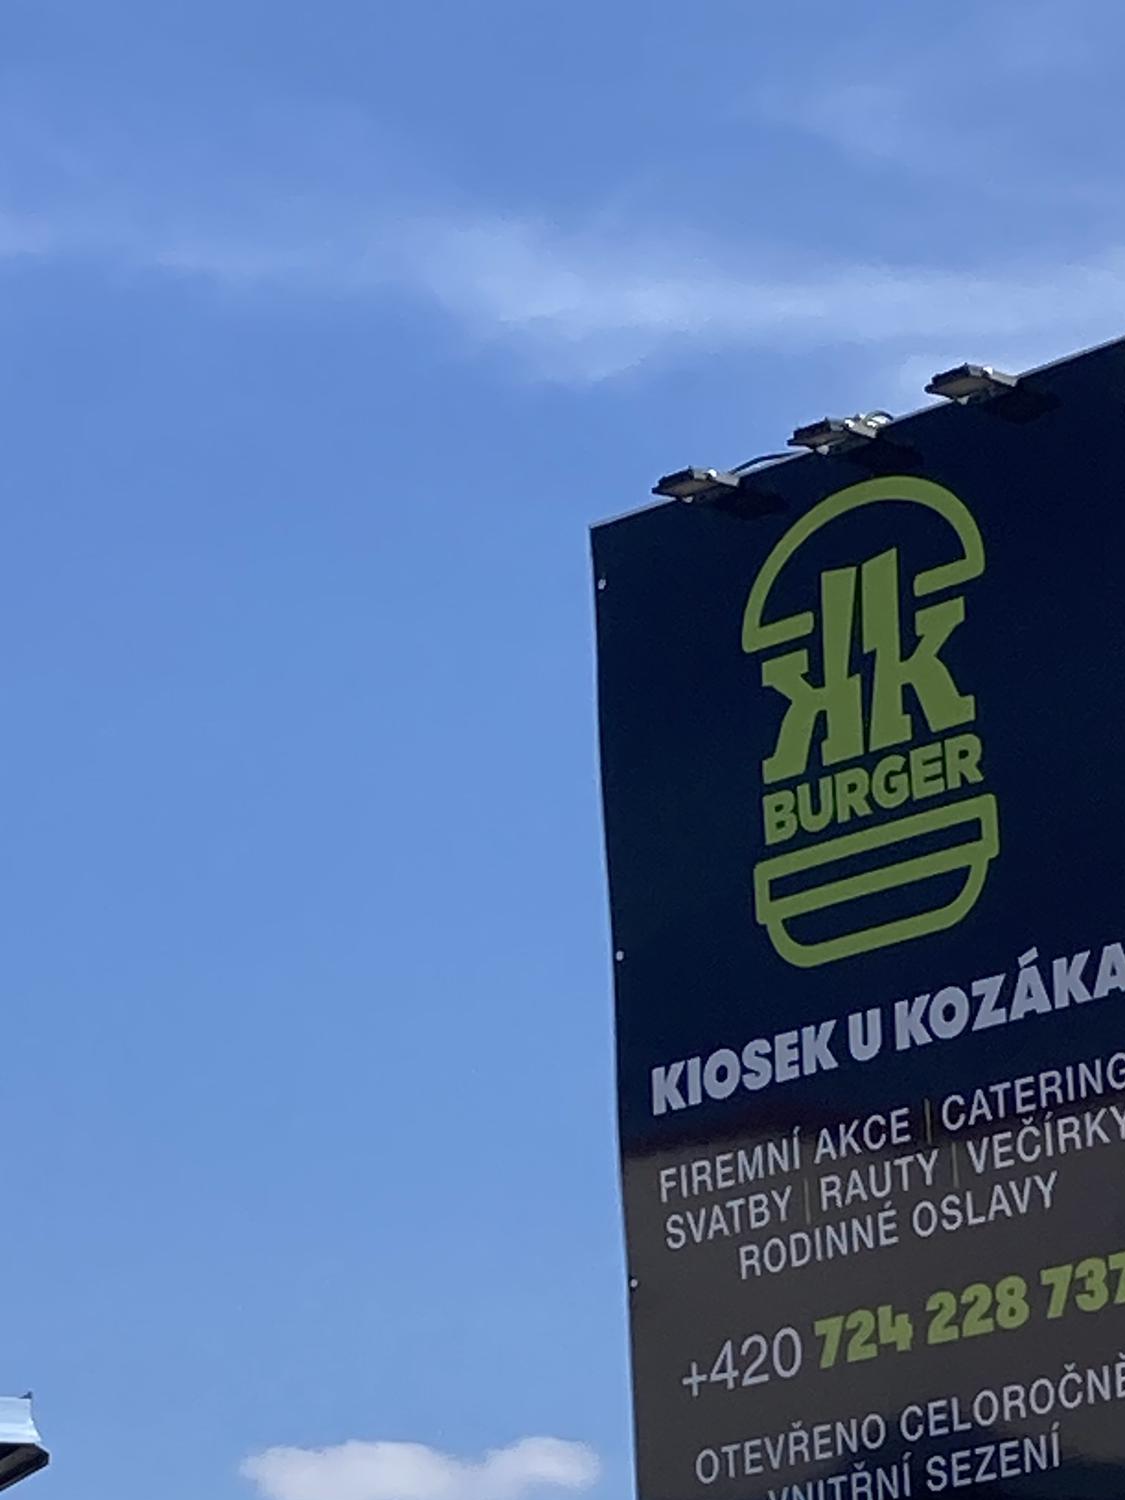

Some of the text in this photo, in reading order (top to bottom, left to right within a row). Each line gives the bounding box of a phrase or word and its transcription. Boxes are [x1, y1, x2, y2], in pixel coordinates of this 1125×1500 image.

[763, 733, 983, 845] BURGER
[651, 1019, 839, 1116] KIOSEK
[848, 1007, 882, 1061] U
[659, 1126, 801, 1203] FIREMNÍ
[814, 1107, 911, 1164] AKCE
[665, 1187, 792, 1250] SVATBY
[819, 1149, 939, 1211] RAUTY
[740, 1170, 1057, 1280] RODINNÉ OSLAVY
[682, 1327, 801, 1397] +420
[814, 1306, 911, 1369] 724
[926, 1275, 1029, 1345] 228
[695, 1413, 886, 1485] OTEVŘENO
[926, 1422, 1061, 1492] SEZENÍ
